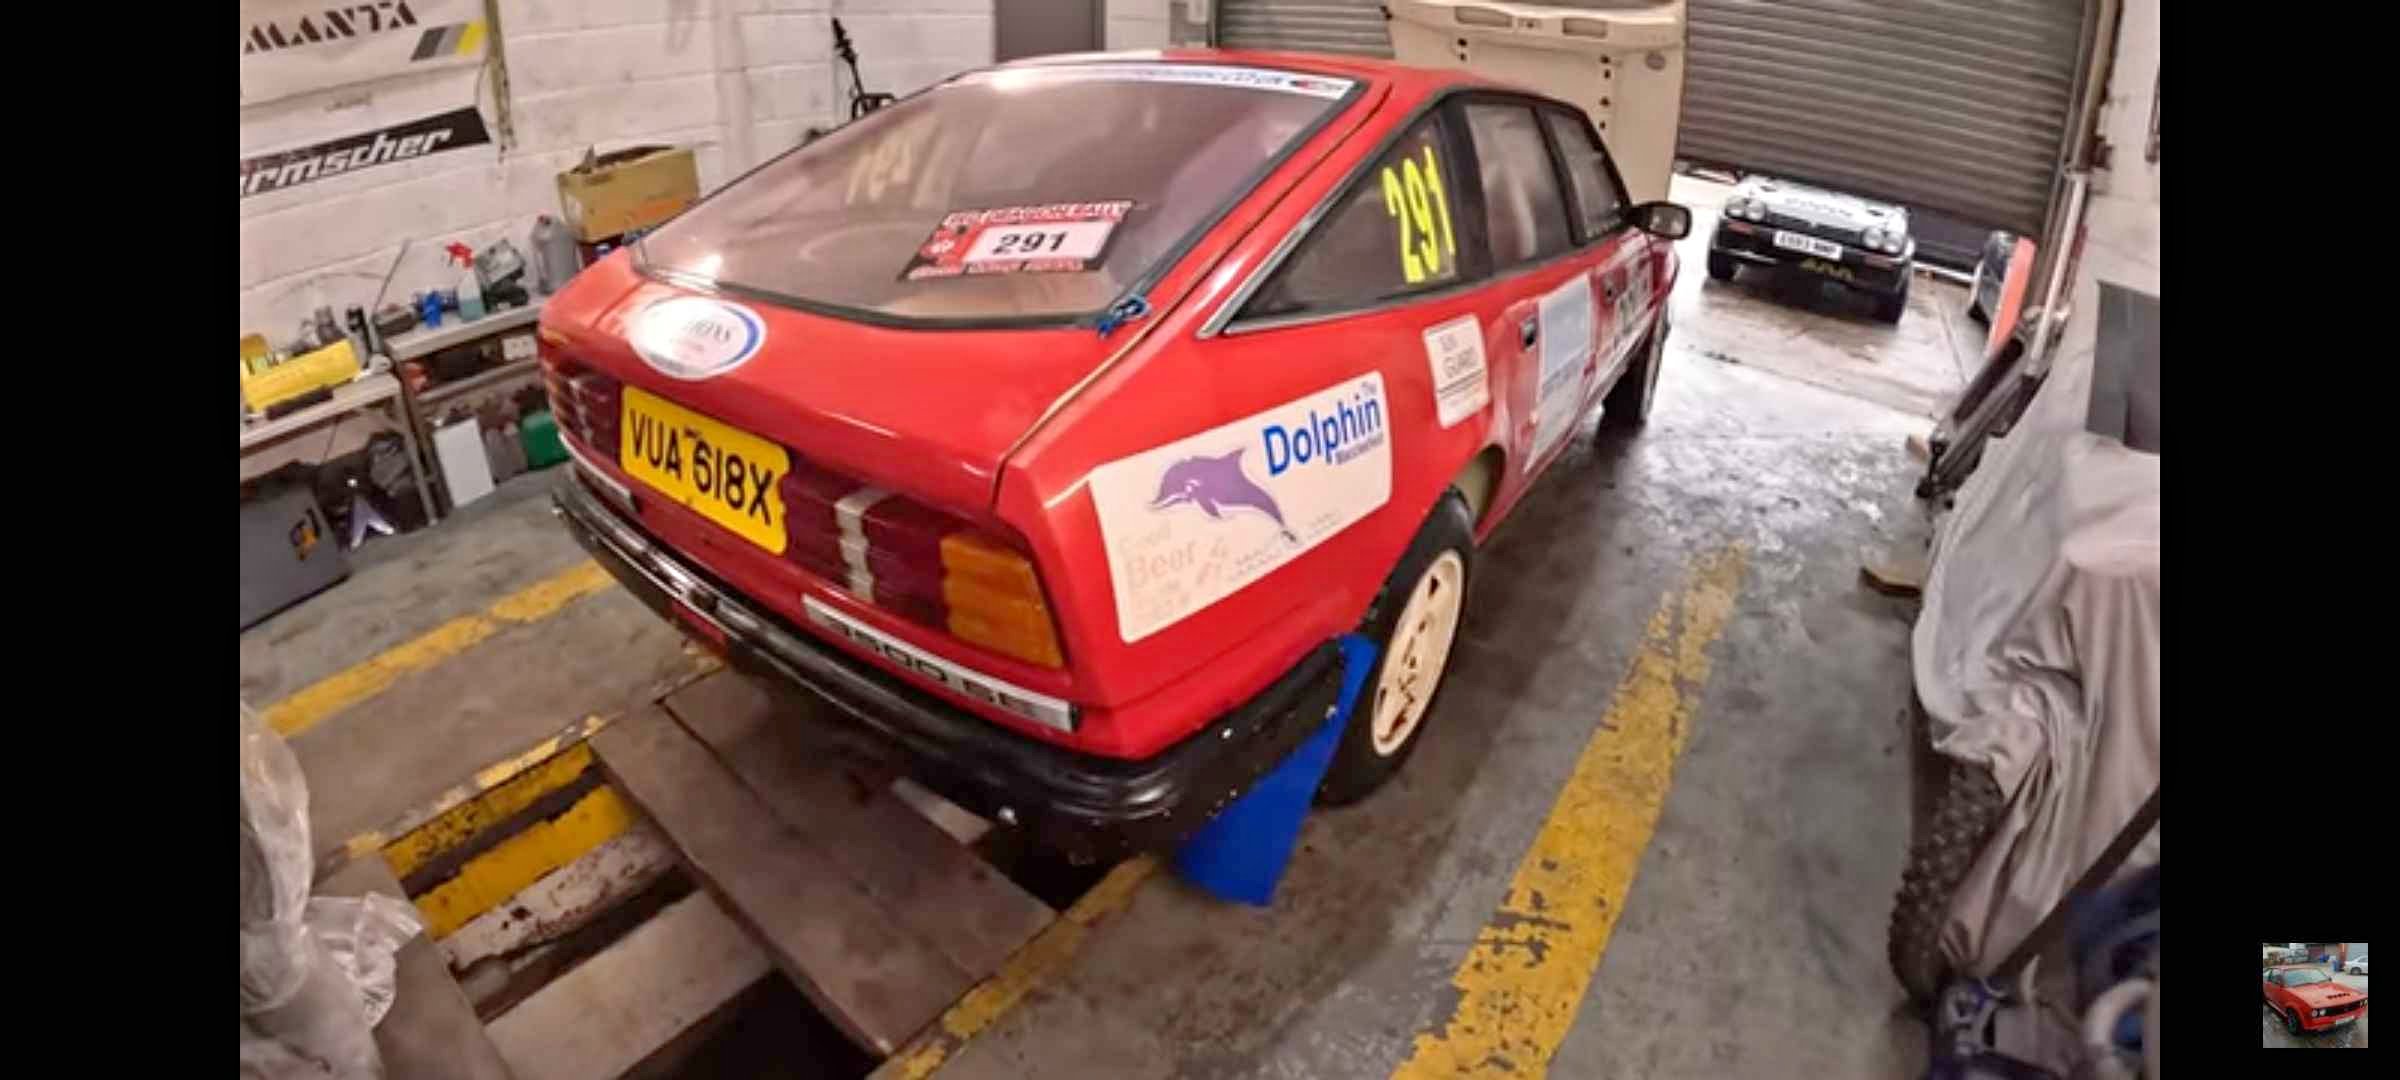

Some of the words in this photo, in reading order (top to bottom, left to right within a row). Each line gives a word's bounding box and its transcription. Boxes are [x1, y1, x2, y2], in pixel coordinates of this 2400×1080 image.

[244, 0, 418, 54] MANTA
[991, 231, 1067, 255] 291
[1382, 145, 1455, 283] 291
[630, 410, 682, 481] VUA
[693, 439, 773, 526] 618X
[1263, 392, 1381, 476] Dolphin
